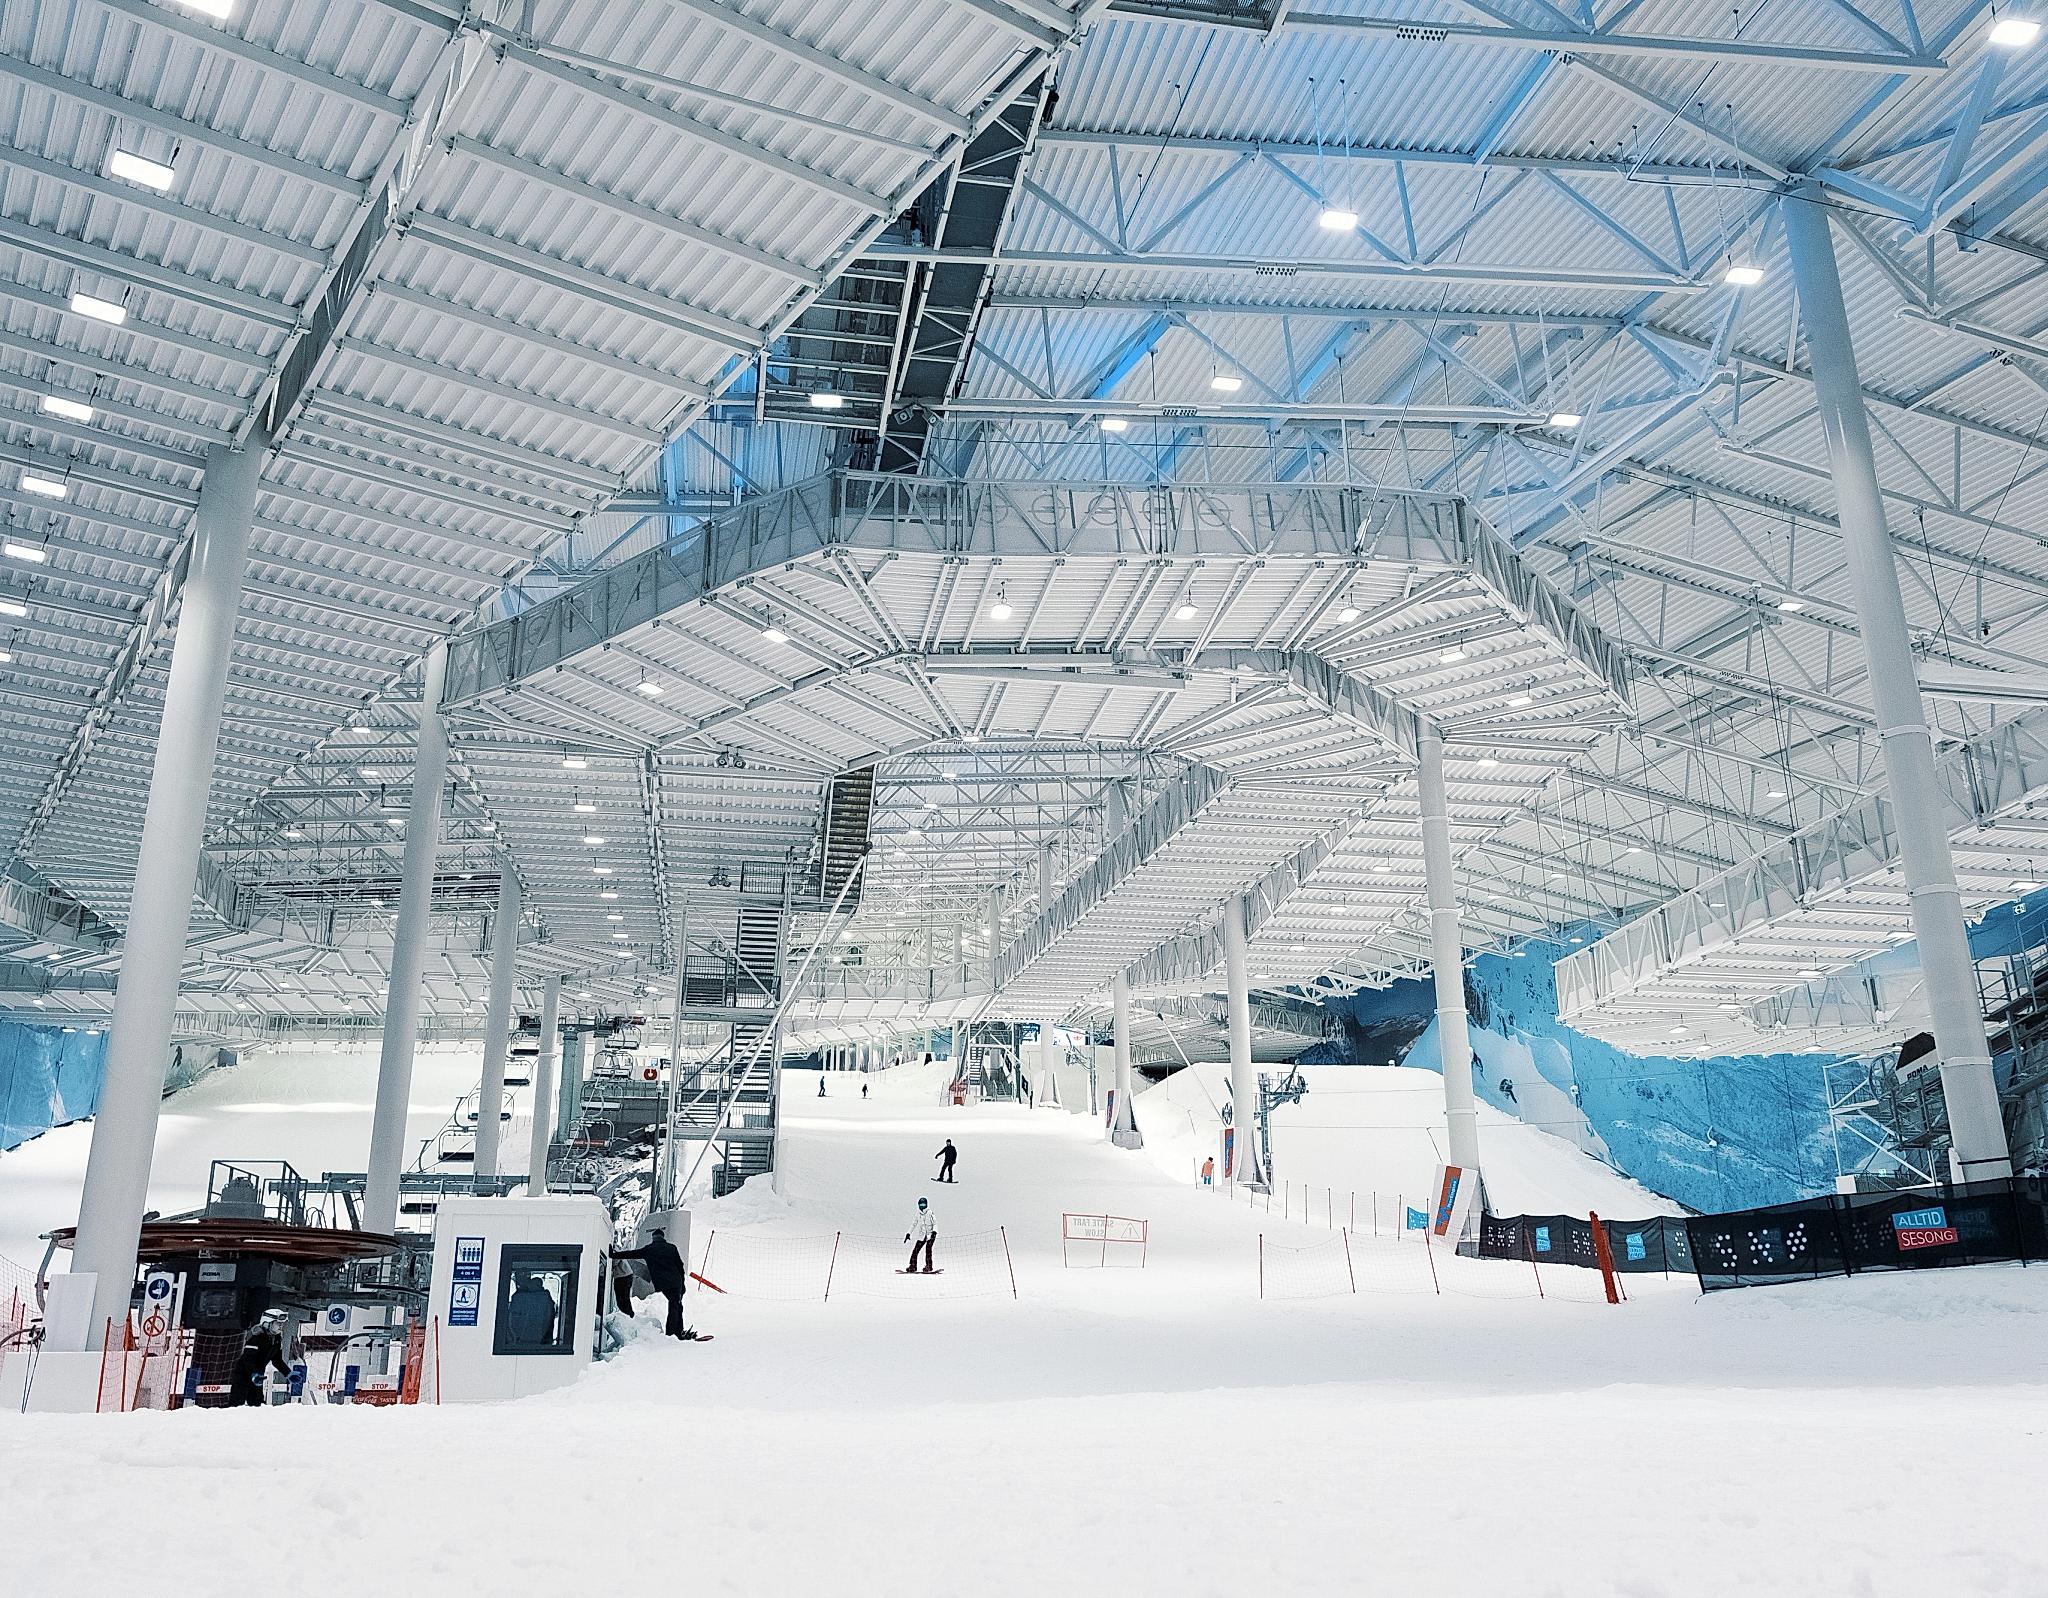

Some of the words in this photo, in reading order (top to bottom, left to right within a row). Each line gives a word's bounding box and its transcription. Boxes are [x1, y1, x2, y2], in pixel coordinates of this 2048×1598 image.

[1906, 1064, 1929, 1081] POMA
[1898, 1211, 1942, 1226] ALLTID
[1901, 1230, 1954, 1247] SESONG
